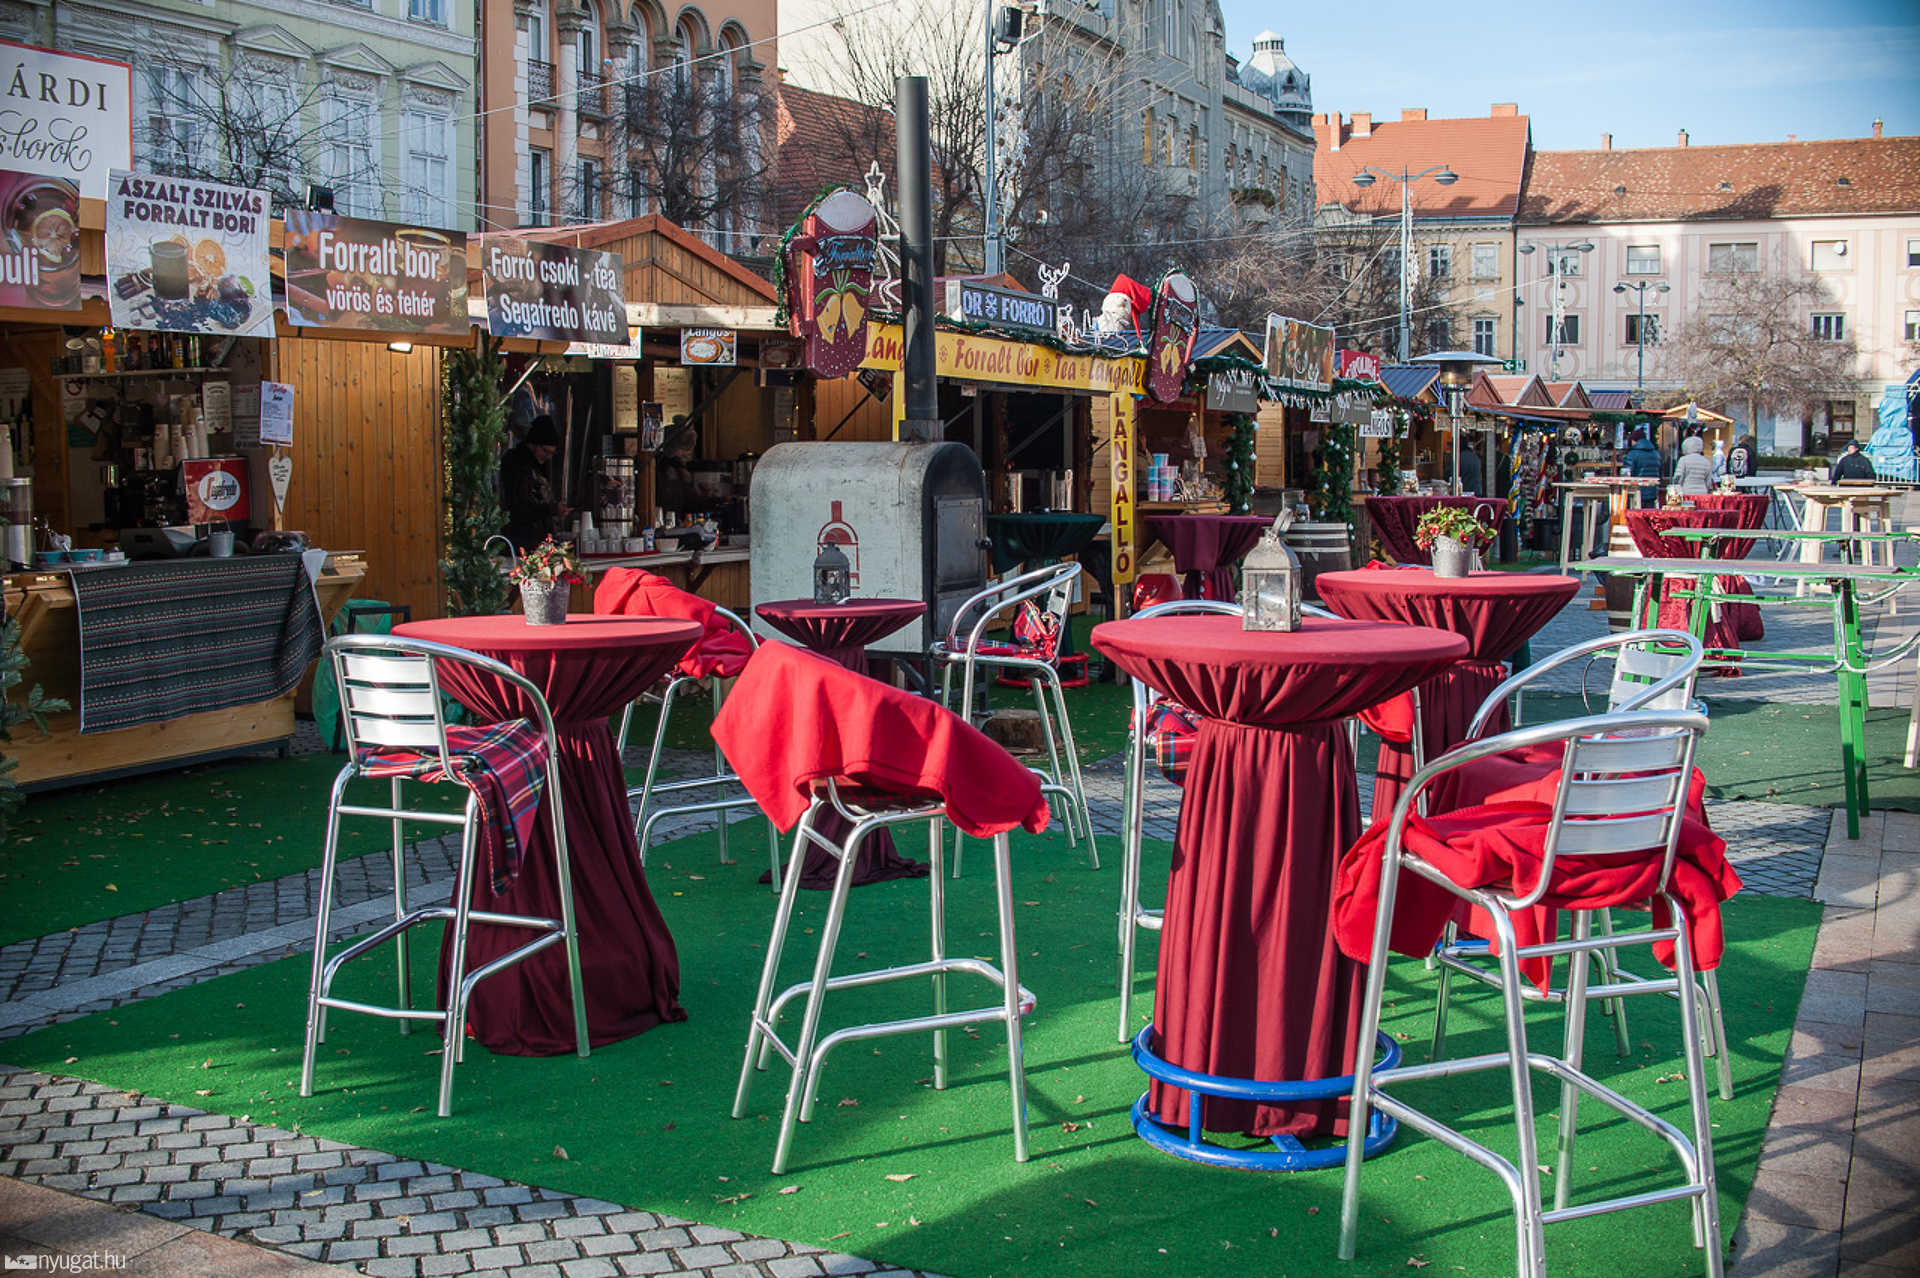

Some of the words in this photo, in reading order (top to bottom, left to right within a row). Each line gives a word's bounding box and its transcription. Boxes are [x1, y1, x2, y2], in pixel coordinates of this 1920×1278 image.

[118, 176, 190, 204] ASZALT
[193, 187, 262, 214] SZILVÁS
[124, 201, 209, 228] FORRALT
[319, 231, 398, 277] Forralt
[404, 240, 441, 280] bor
[491, 247, 535, 281] Forró
[539, 257, 579, 287] csoki
[326, 284, 371, 312] vörös
[375, 289, 394, 314] és
[398, 288, 436, 317] fehér
[500, 294, 578, 332] Segafredo
[583, 301, 617, 333] kávé
[1002, 296, 1045, 326] FORRÓ
[954, 338, 1012, 374] Forralt
[1017, 347, 1040, 377] bor
[1054, 351, 1077, 380] Tea
